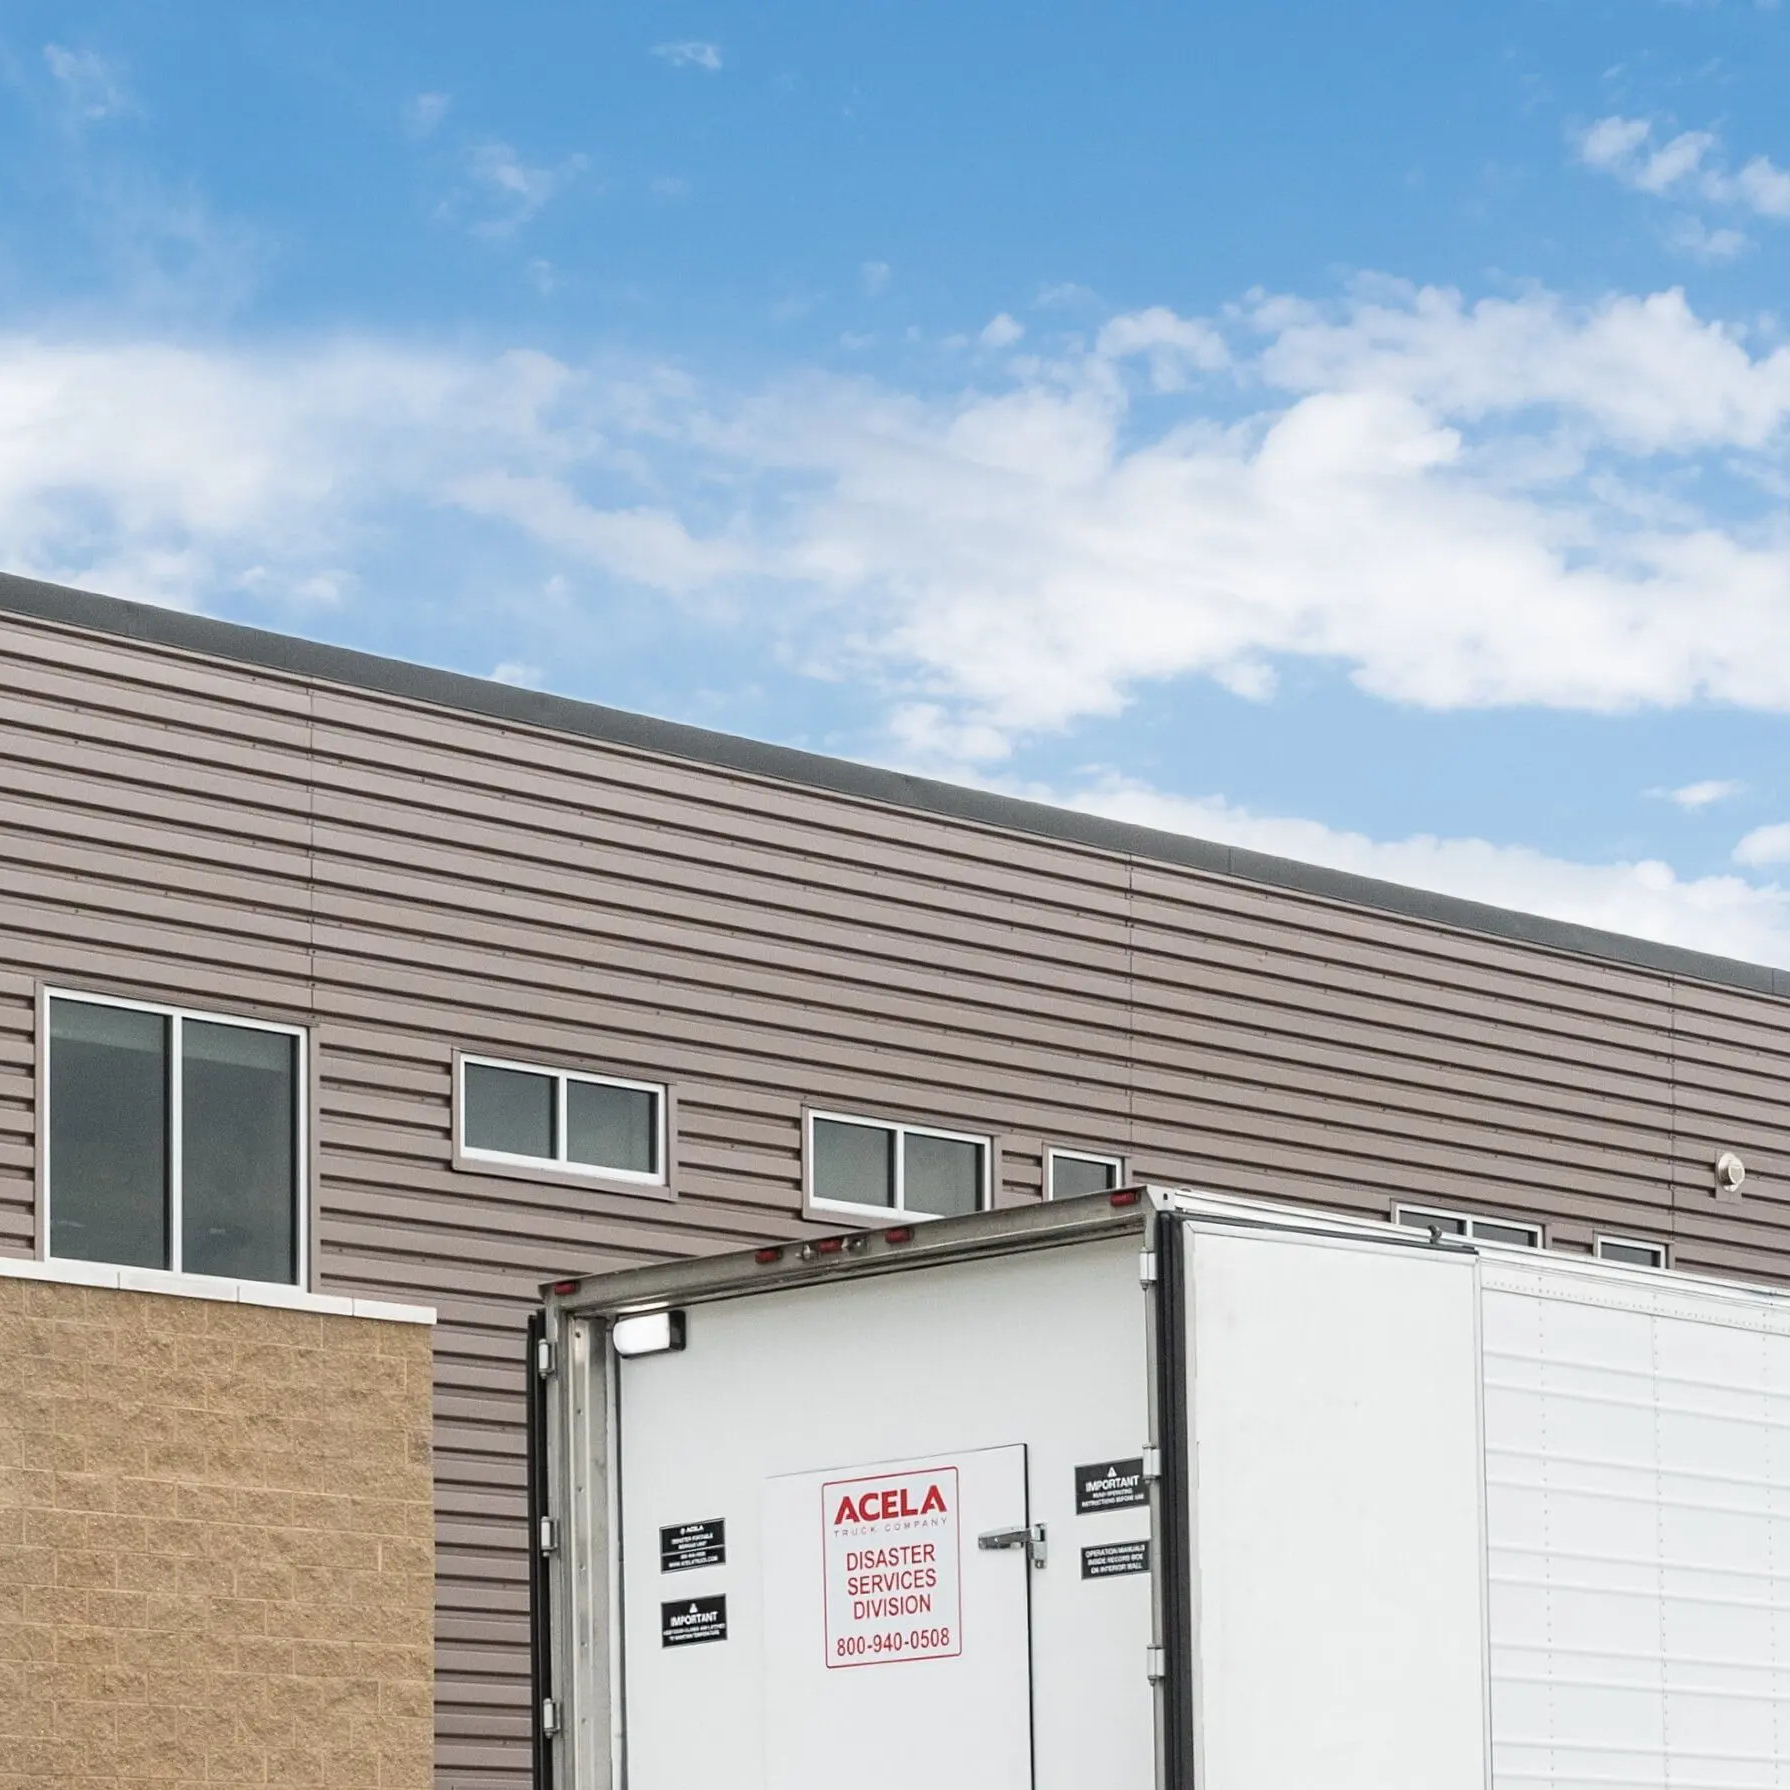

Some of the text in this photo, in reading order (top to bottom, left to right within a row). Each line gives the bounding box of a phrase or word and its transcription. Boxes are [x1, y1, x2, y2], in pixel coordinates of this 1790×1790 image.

[1085, 1474, 1140, 1492] IMPORTANT
[834, 1485, 948, 1525] ACELA
[834, 1517, 948, 1537] TRUCK COMPANY
[846, 1543, 936, 1572] DISASTER
[847, 1568, 937, 1596] SERVICES
[670, 1610, 718, 1627] IMPORTANT
[853, 1594, 931, 1620] DIVISION
[837, 1627, 950, 1657] 800-940-0508
